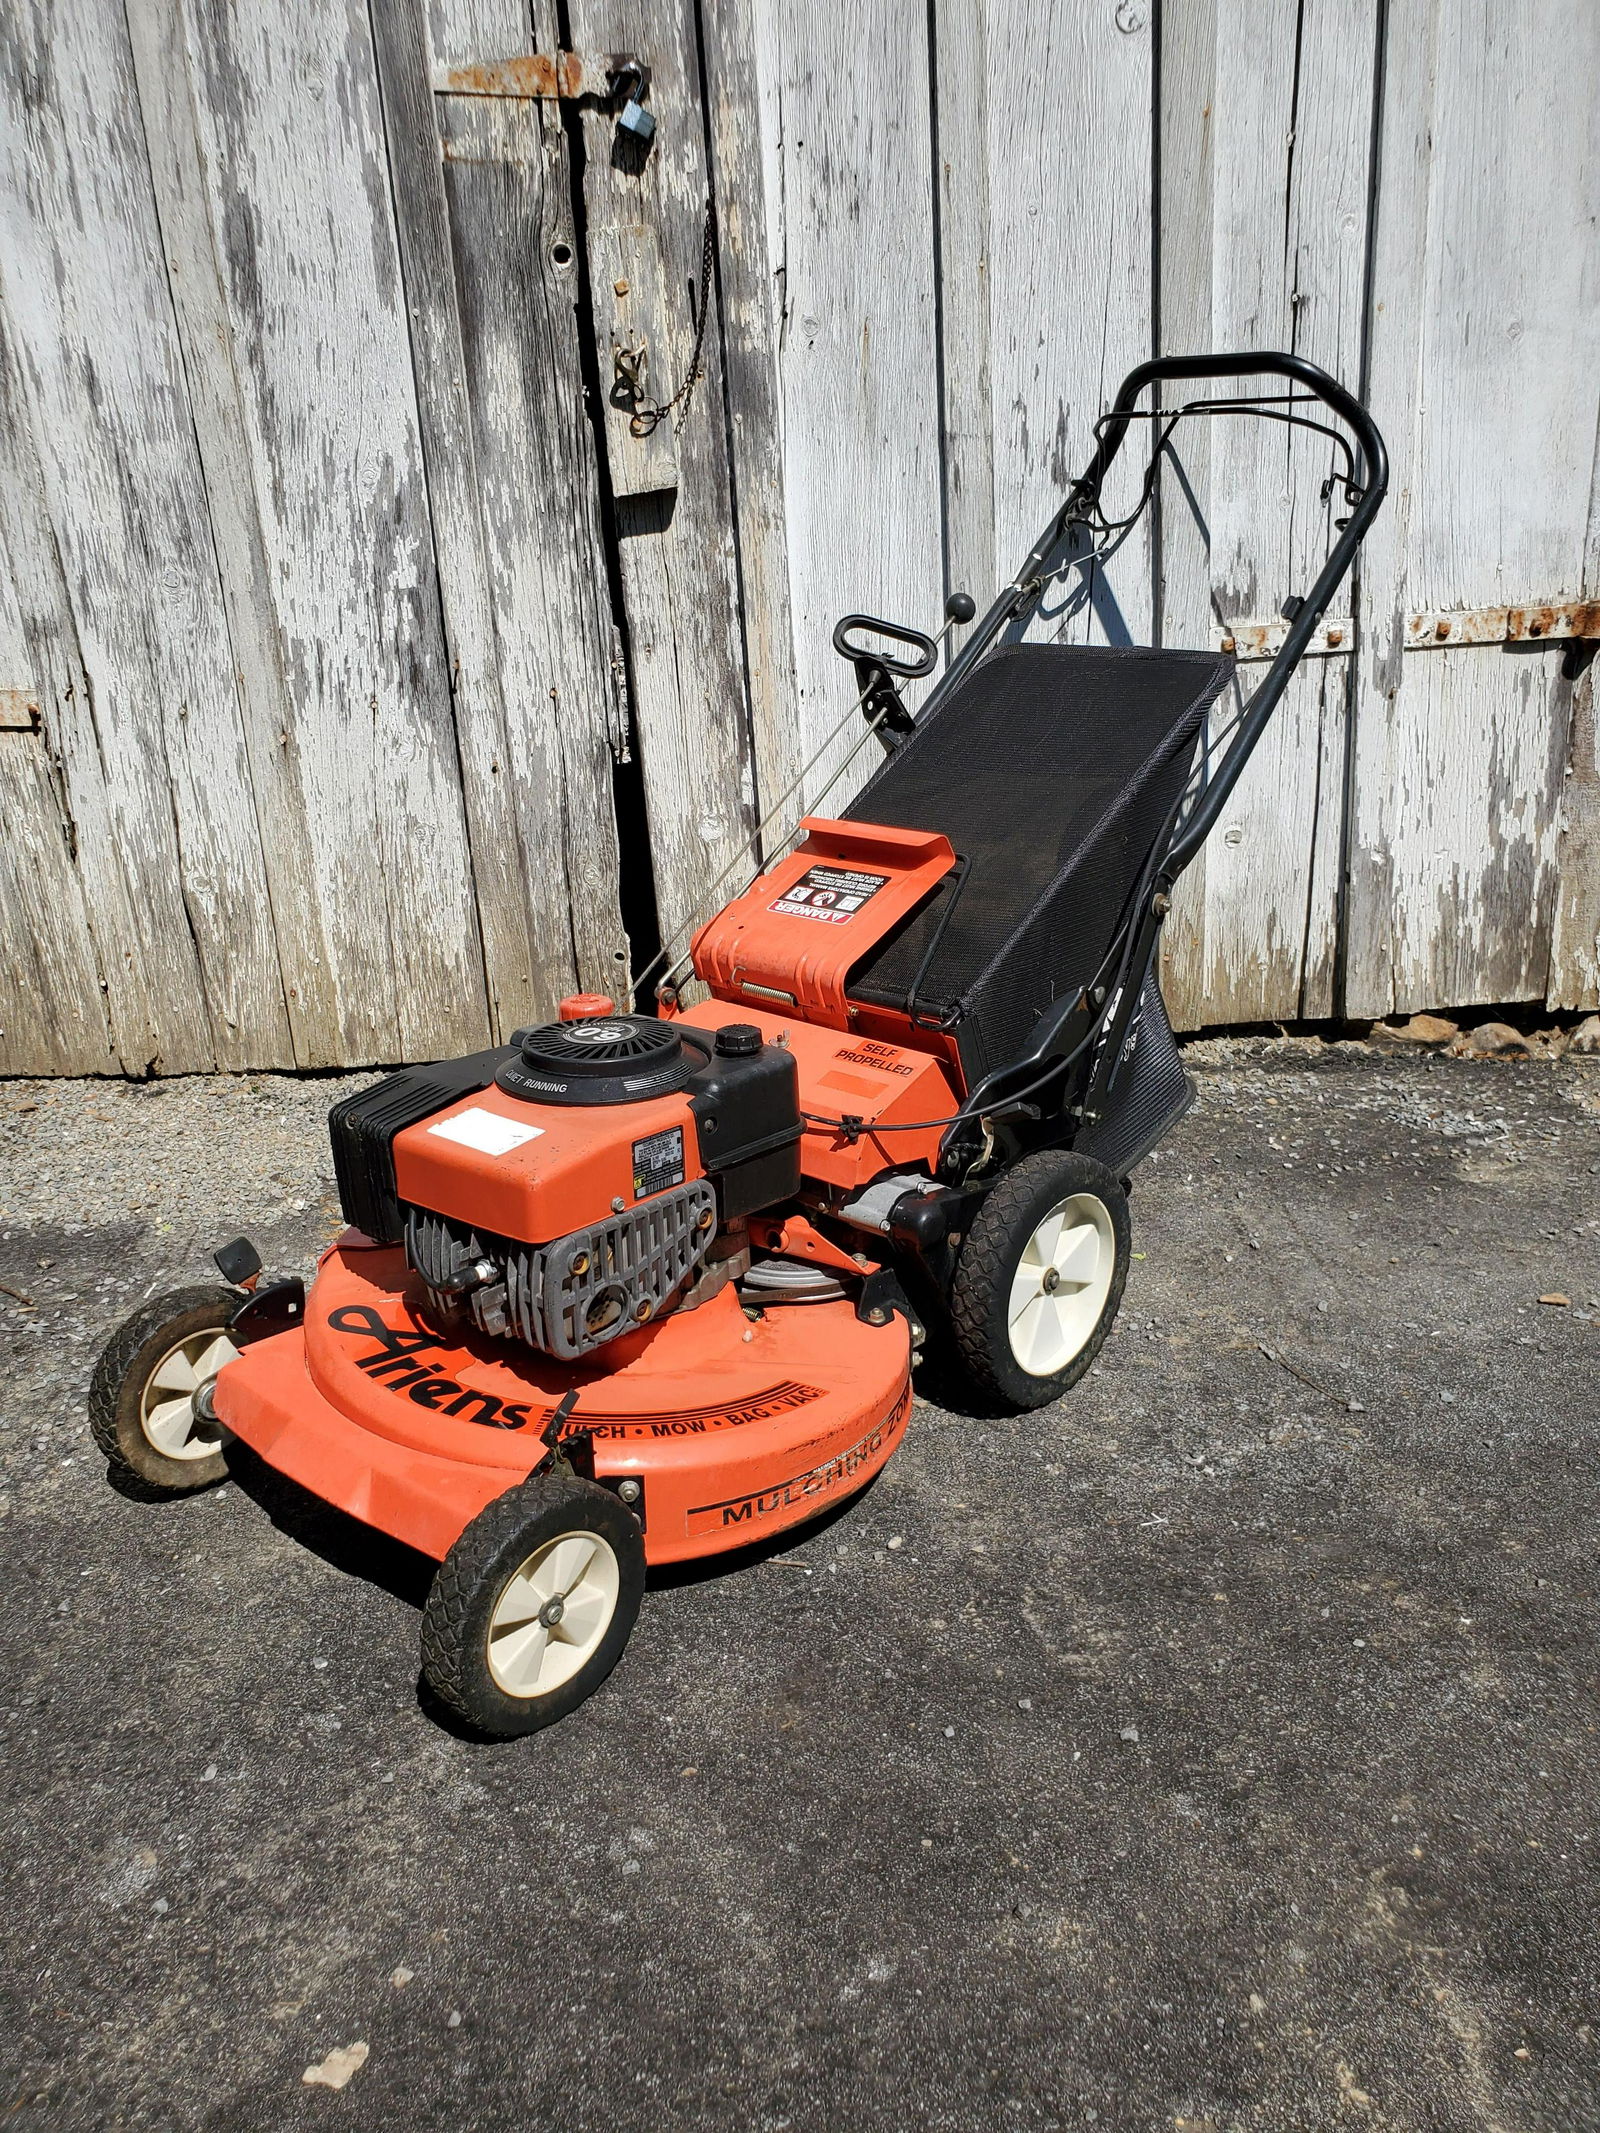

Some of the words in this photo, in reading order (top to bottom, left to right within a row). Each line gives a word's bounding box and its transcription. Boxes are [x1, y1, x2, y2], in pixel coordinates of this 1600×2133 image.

[775, 902, 833, 919] DANGER
[835, 1049, 914, 1076] PROPELLED
[862, 1043, 898, 1058] SELF
[505, 1069, 525, 1084] QUIET
[523, 1078, 568, 1093] RUNNING
[327, 1304, 534, 1431] Ariens
[557, 1423, 626, 1439] UCH
[650, 1419, 706, 1437] MOW
[724, 1406, 771, 1426] BAG
[777, 1388, 820, 1408] VAC
[721, 1431, 882, 1526] MULCHING
[886, 1382, 910, 1438] ZON
